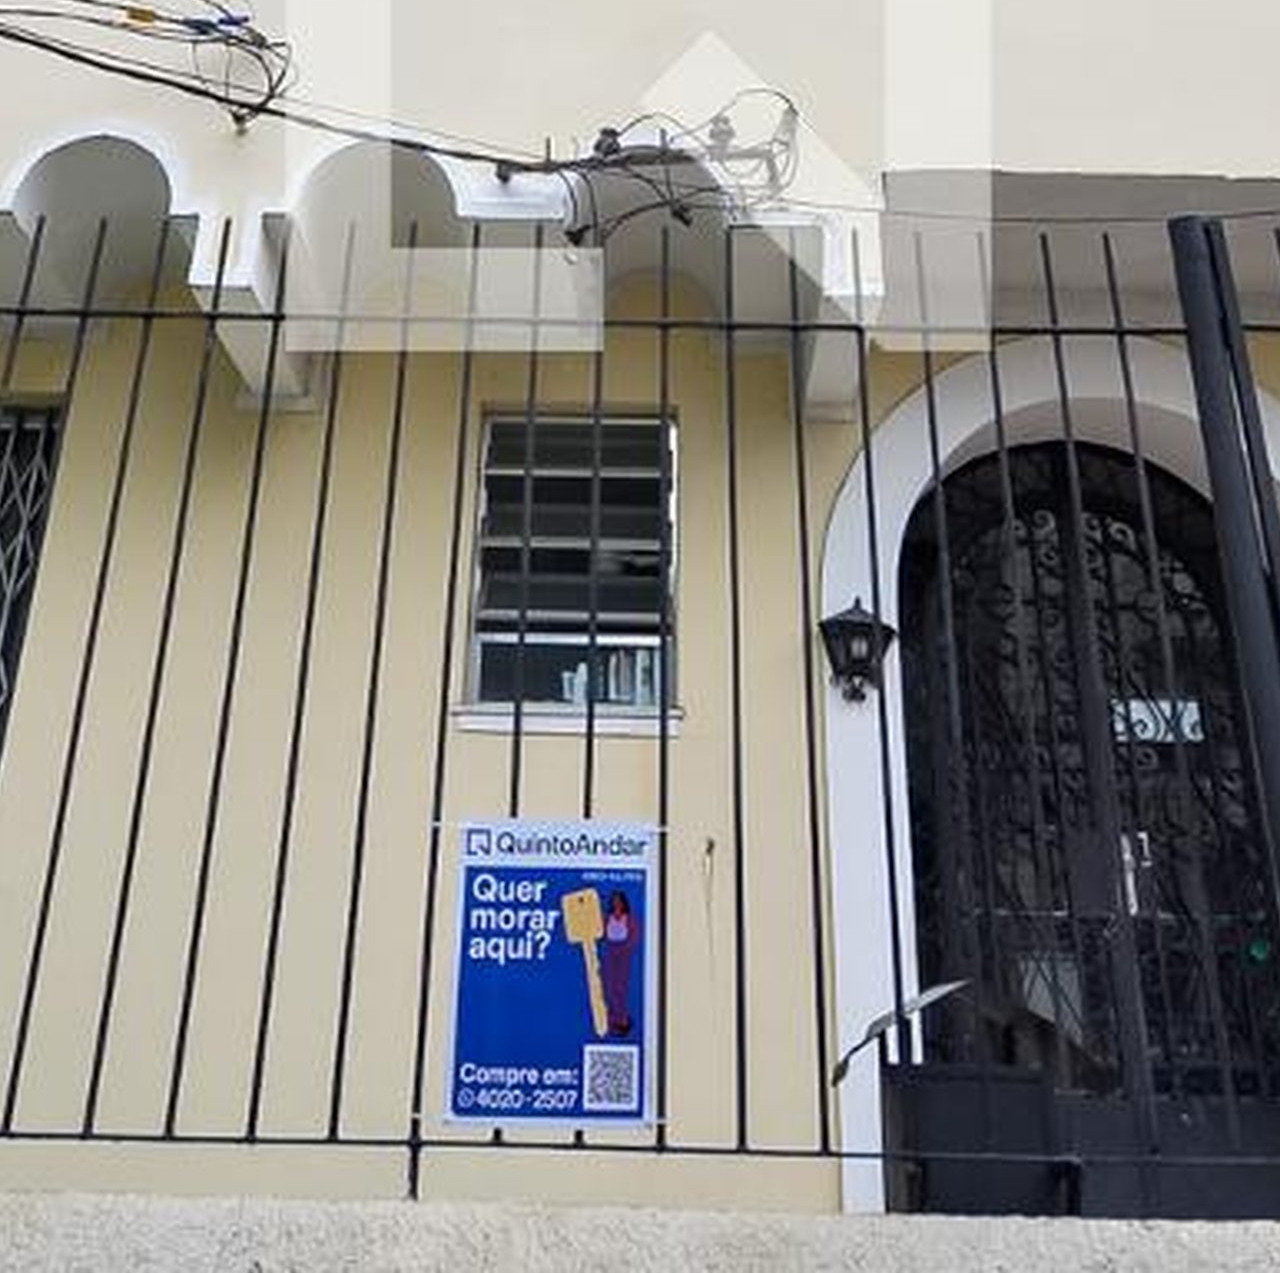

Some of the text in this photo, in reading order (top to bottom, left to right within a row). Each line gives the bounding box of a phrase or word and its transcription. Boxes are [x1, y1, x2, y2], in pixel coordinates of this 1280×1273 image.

[497, 832, 646, 855] QuintoAndar
[473, 874, 546, 903] Quer
[471, 908, 559, 930] morar
[470, 931, 551, 965] aqui?
[460, 1063, 578, 1087] Compre em:
